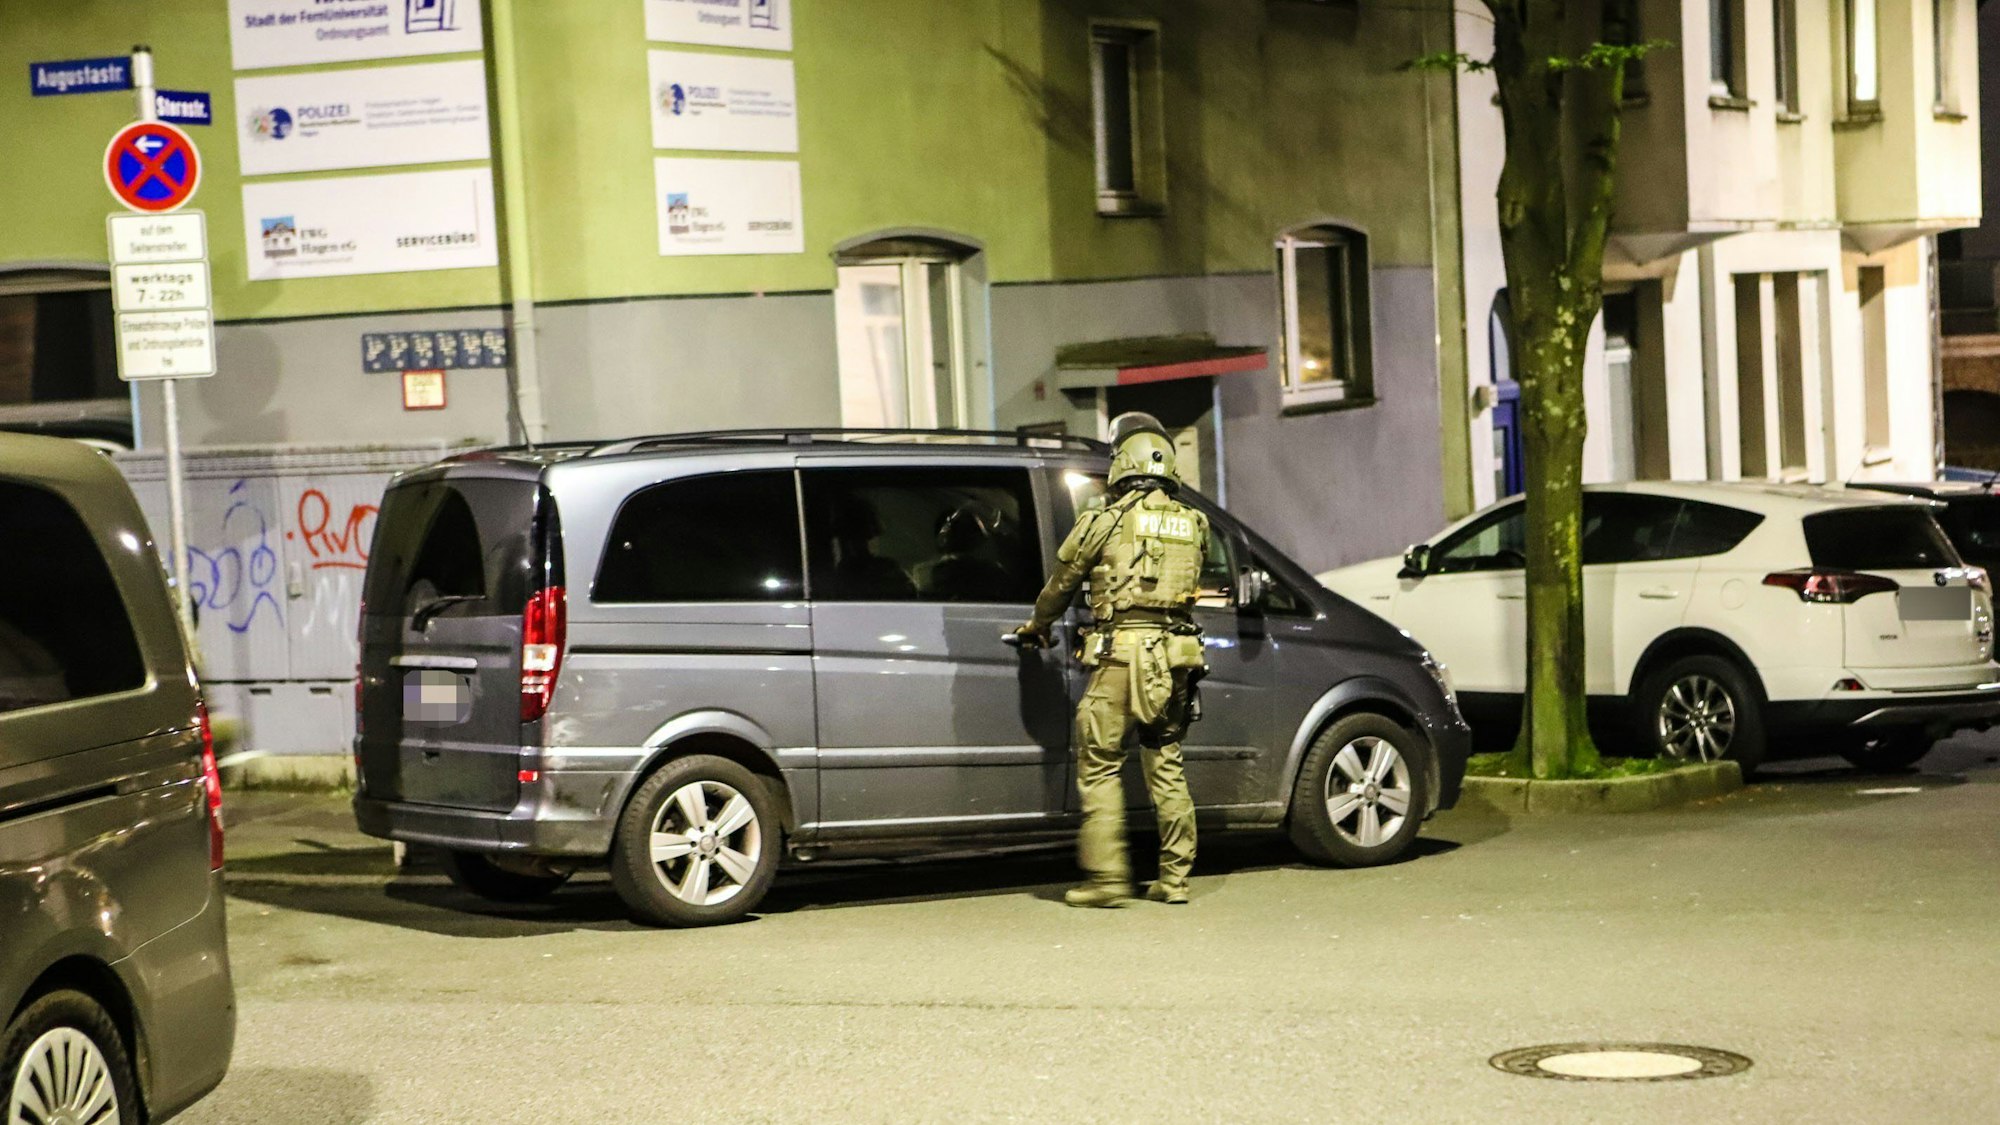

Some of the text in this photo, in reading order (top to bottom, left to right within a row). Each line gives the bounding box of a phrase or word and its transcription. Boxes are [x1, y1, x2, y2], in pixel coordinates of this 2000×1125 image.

[245, 14, 276, 28] Stadt
[279, 13, 297, 25] der
[37, 63, 125, 92] Augustastr.
[298, 104, 350, 119] POLIZEI
[130, 273, 193, 286] werktags
[138, 289, 145, 302] 7
[160, 289, 184, 301] 22h
[1140, 515, 1191, 537] POLIZEI
